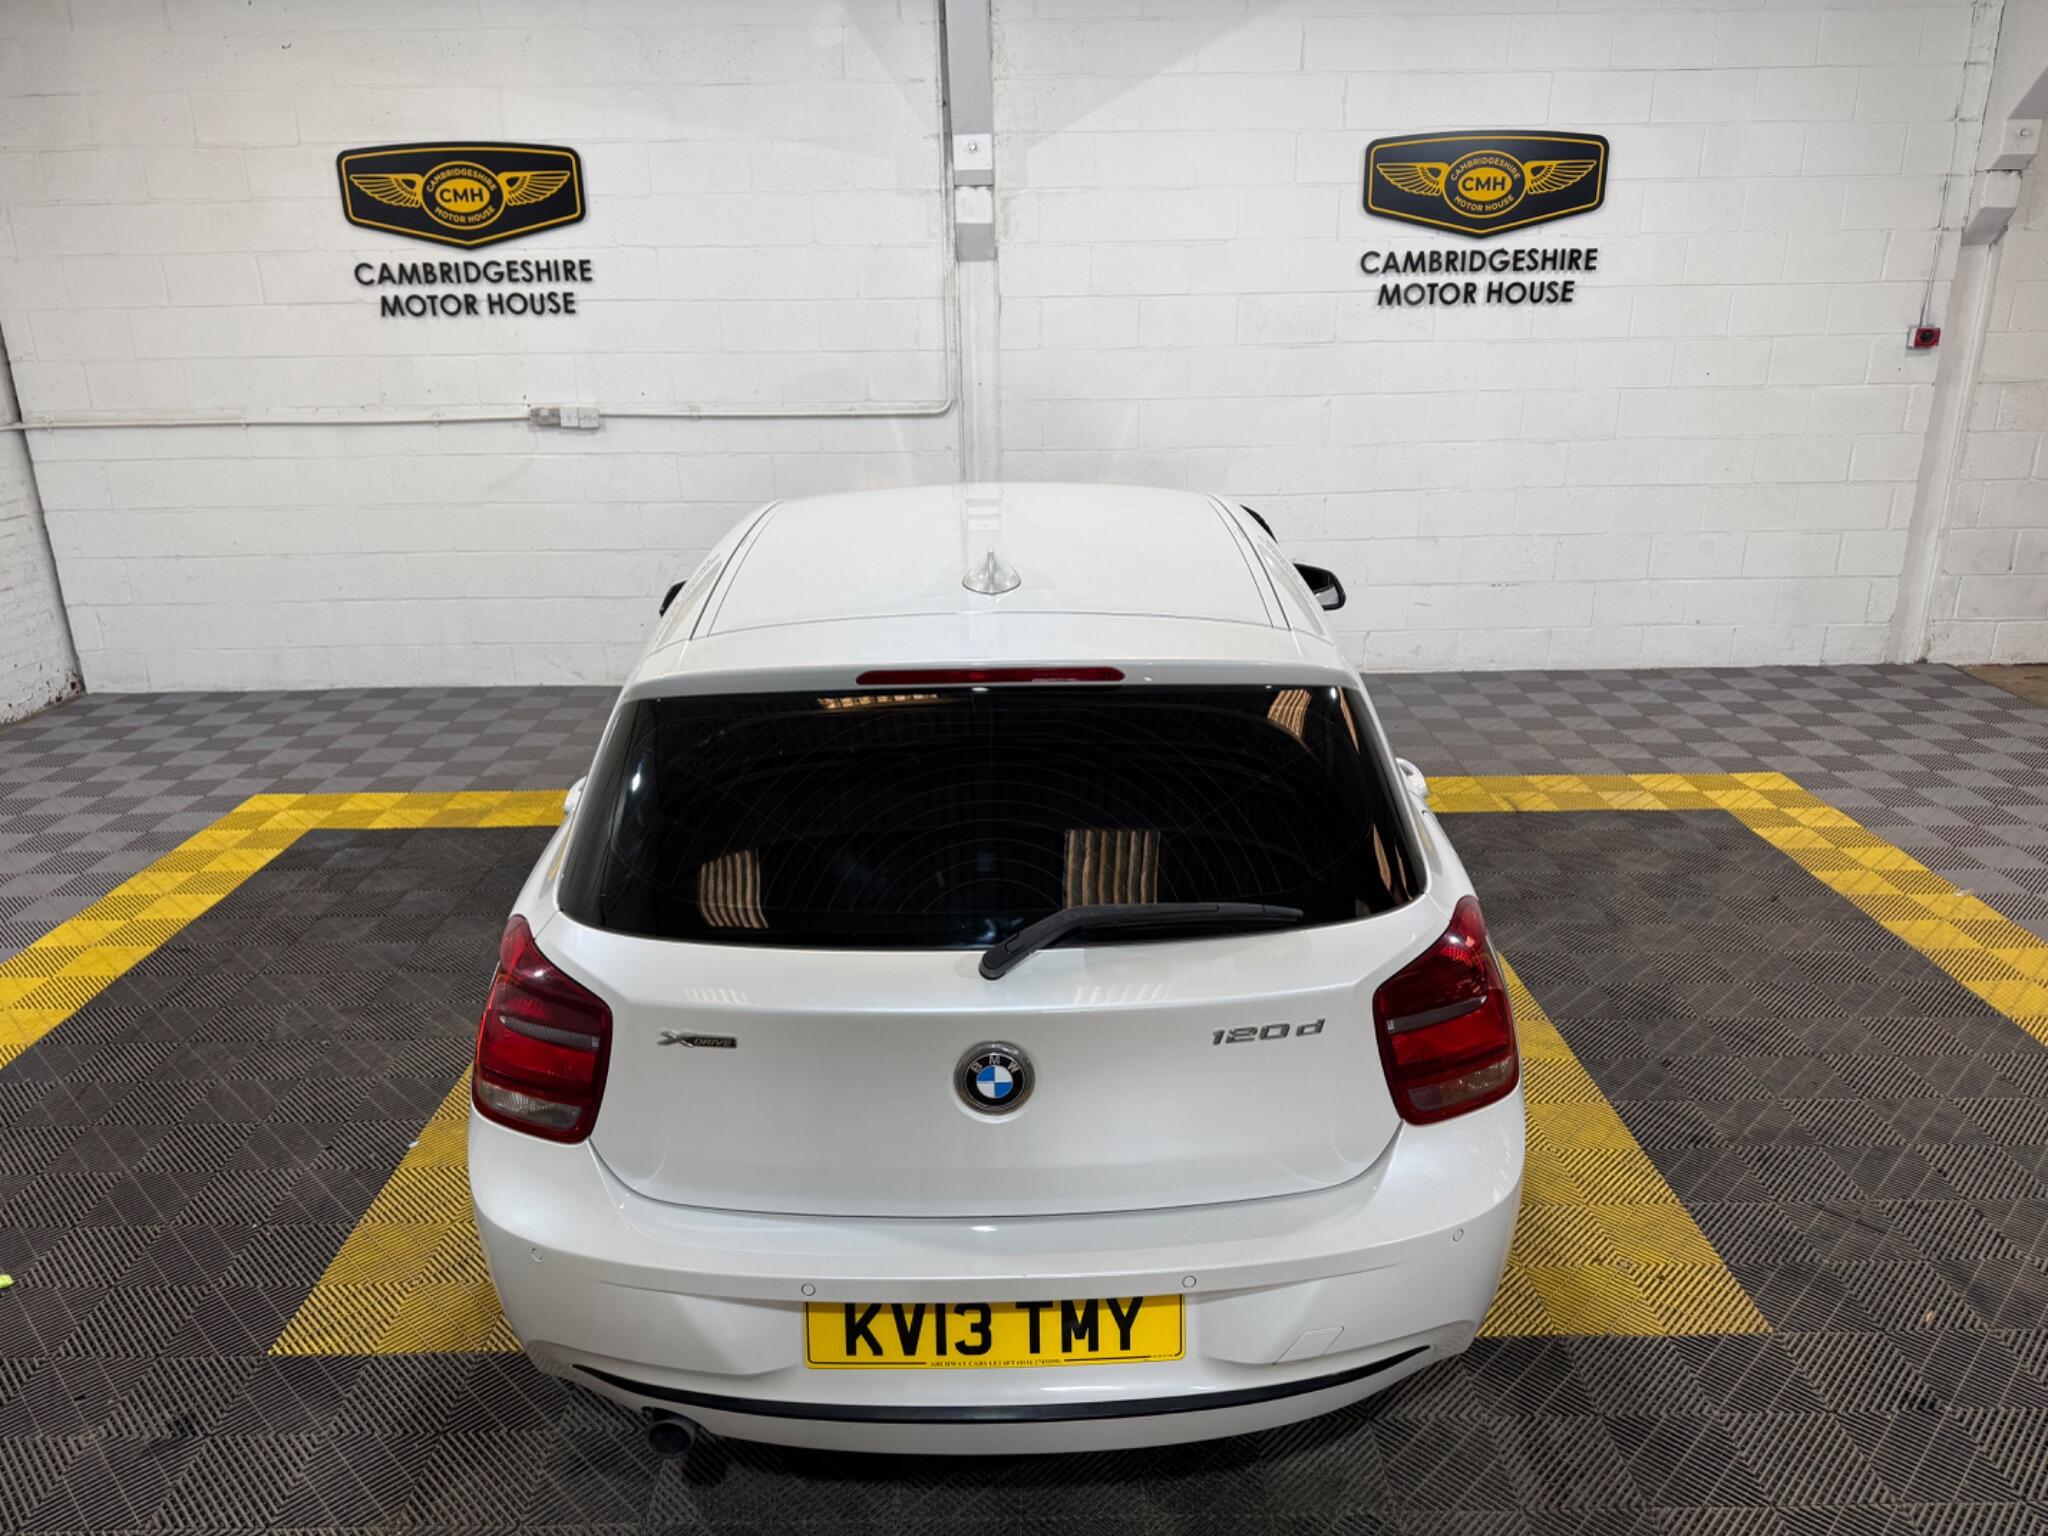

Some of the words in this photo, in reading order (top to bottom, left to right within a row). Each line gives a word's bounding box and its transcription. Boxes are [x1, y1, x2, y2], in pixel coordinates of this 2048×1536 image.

[426, 168, 498, 193] CAMBRIDGESHIRE
[1451, 156, 1521, 181] CAMBRIDGESHIRE
[439, 187, 485, 203] CMH
[1461, 176, 1507, 192] CMH
[434, 206, 467, 224] MOTOR
[468, 205, 496, 224] HOUSE
[1454, 195, 1484, 212] MOTOR
[1485, 194, 1514, 212] HOUSE
[354, 259, 593, 286] CAMBRIDGESHIRE
[1360, 247, 1599, 275] CAMBRIDGESHIRE
[380, 293, 479, 317] MOTOR
[487, 291, 577, 315] HOUSE
[1377, 282, 1478, 307] MOTOR
[1486, 280, 1576, 305] HOUSE
[970, 1054, 1021, 1074] BMW
[844, 1302, 992, 1357] KV13
[1015, 1296, 1144, 1354] TMY
